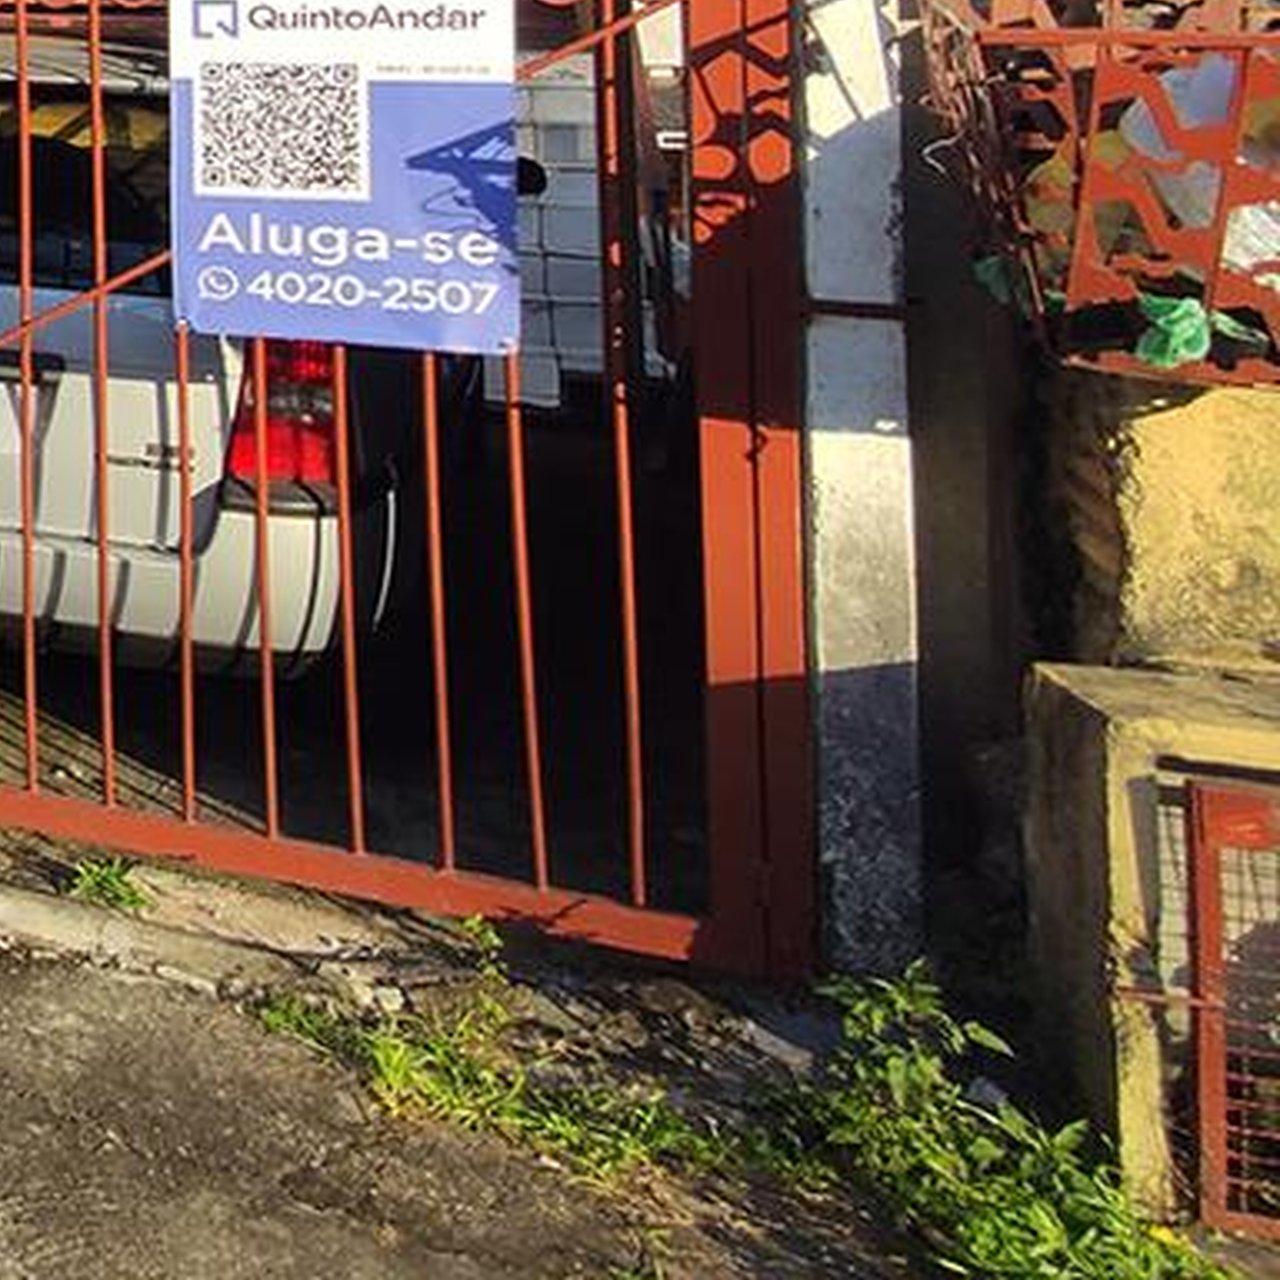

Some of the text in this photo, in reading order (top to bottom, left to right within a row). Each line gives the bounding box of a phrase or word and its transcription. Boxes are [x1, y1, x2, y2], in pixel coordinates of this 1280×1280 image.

[247, 3, 487, 33] QuintoAndar
[199, 214, 499, 266] Aluga-se
[247, 271, 499, 315] 4020-2507
